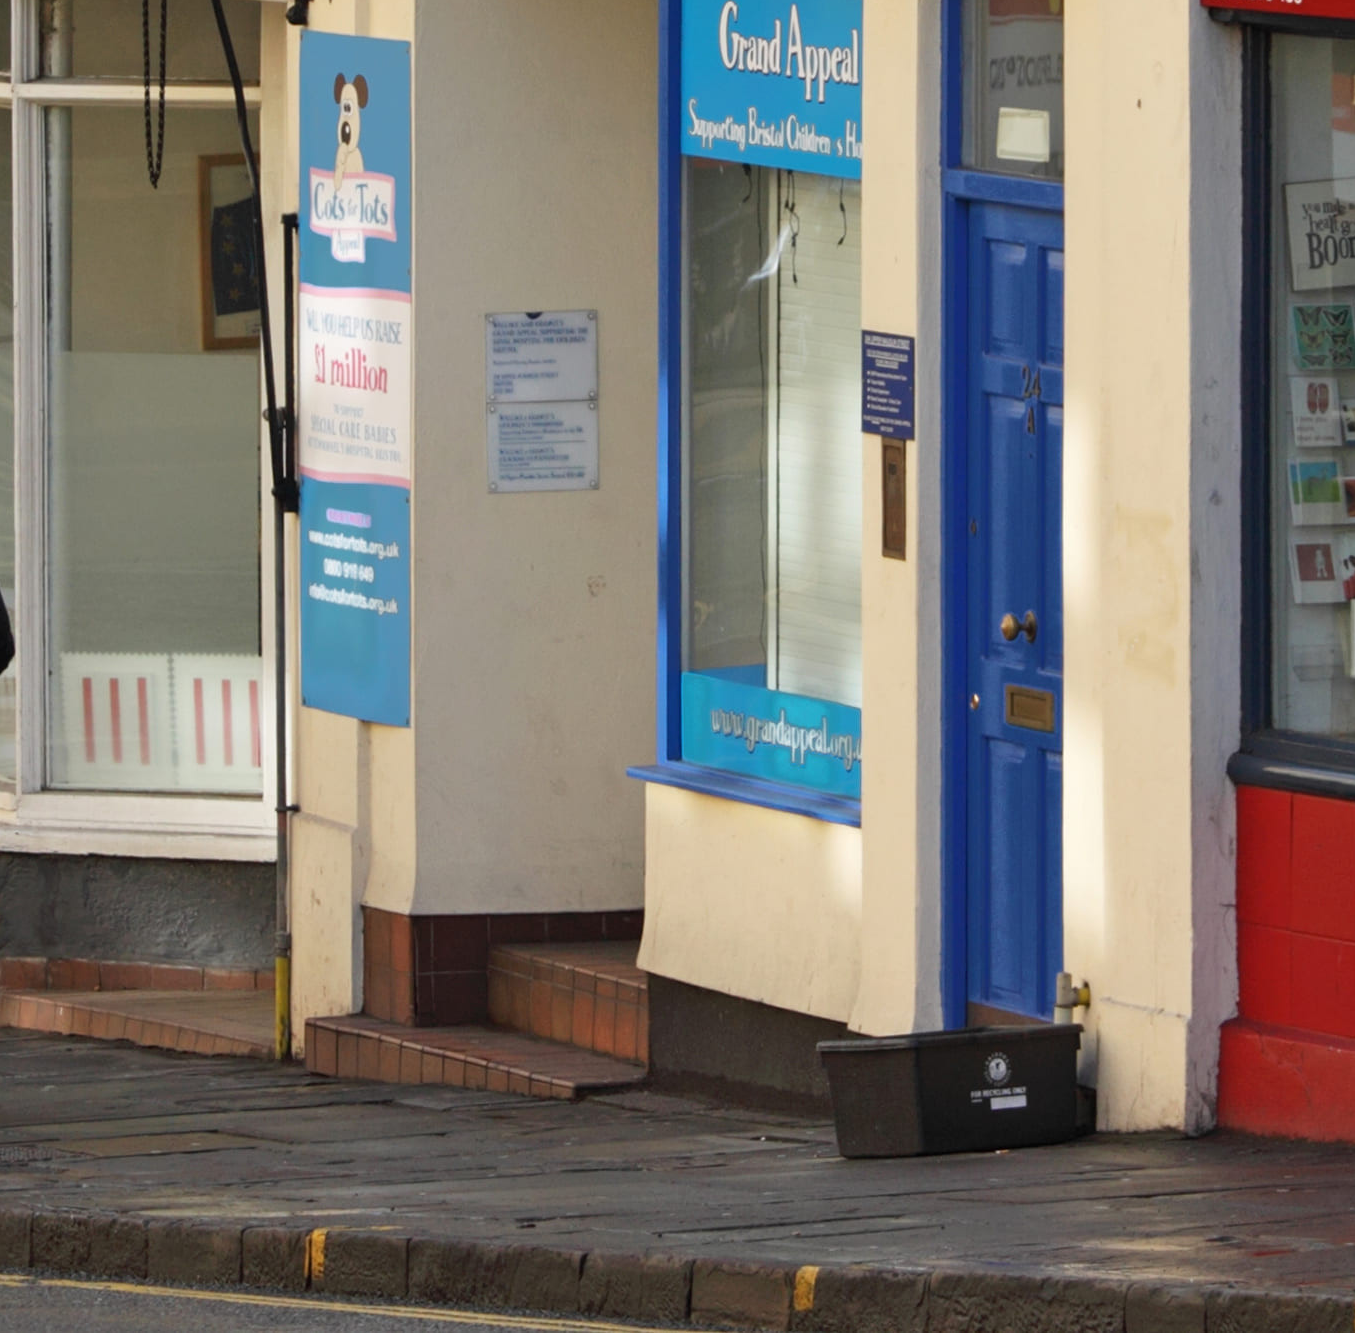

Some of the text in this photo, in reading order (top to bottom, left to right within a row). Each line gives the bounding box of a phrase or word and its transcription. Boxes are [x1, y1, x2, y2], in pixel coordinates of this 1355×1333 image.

[719, 0, 859, 103] Grand Appeal
[688, 98, 746, 151] Supporting
[748, 107, 785, 148] Bristol
[314, 182, 345, 220] Cots
[356, 183, 389, 225] Tots
[361, 318, 374, 341] US
[375, 320, 402, 344] RAISE
[331, 348, 388, 394] million
[1022, 365, 1042, 400] 24
[339, 419, 360, 441] CARE
[364, 424, 396, 444] BABIES
